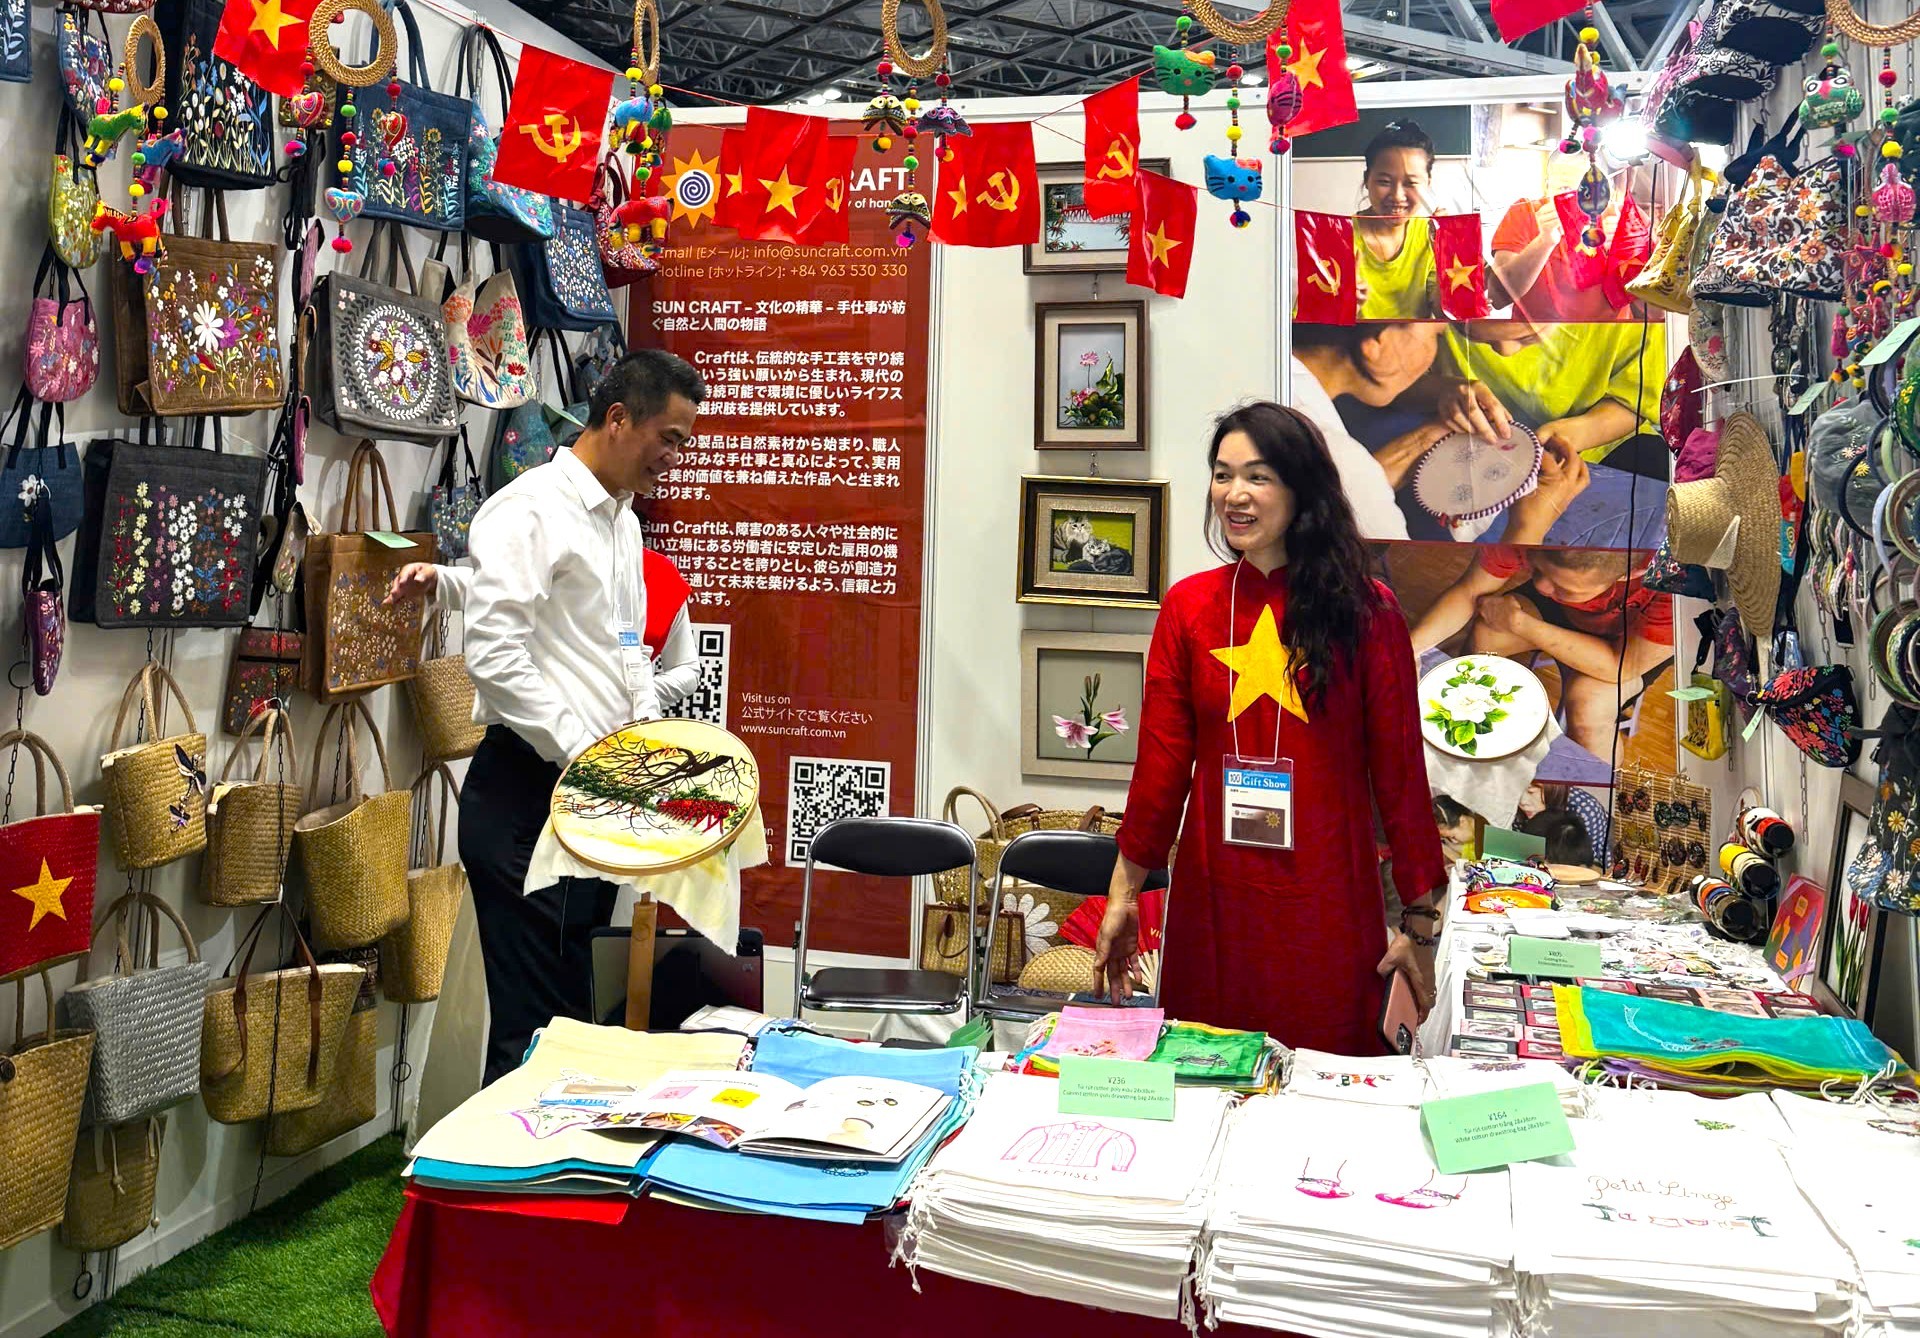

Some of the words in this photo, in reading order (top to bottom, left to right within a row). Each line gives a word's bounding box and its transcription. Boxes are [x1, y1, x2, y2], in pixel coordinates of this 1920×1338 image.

[854, 197, 867, 209] of
[753, 243, 908, 261] info@suncraft.com.vn
[790, 264, 817, 278] +84
[820, 264, 846, 278] 963
[850, 264, 877, 278] 530
[880, 264, 908, 278] 330
[652, 301, 686, 315] SUN
[688, 301, 742, 315] CRAFT
[755, 300, 823, 315] 文化の精華
[836, 300, 907, 316] 手仕事が紡
[652, 317, 768, 333] ぐ自然と人間の物語
[697, 367, 905, 384] いう強い願いから生まれ、現代の
[742, 692, 763, 704] Visit
[764, 695, 777, 704] us
[778, 695, 792, 705] on
[742, 706, 874, 725] 公式サイトでご覧ください
[740, 724, 847, 739] www.suncraft.com.vn
[1242, 776, 1262, 787] Gift
[1263, 778, 1289, 789] Show
[1107, 1076, 1126, 1085] ¥236
[1488, 1110, 1508, 1121] ¥164
[1588, 1174, 1652, 1201] Petit
